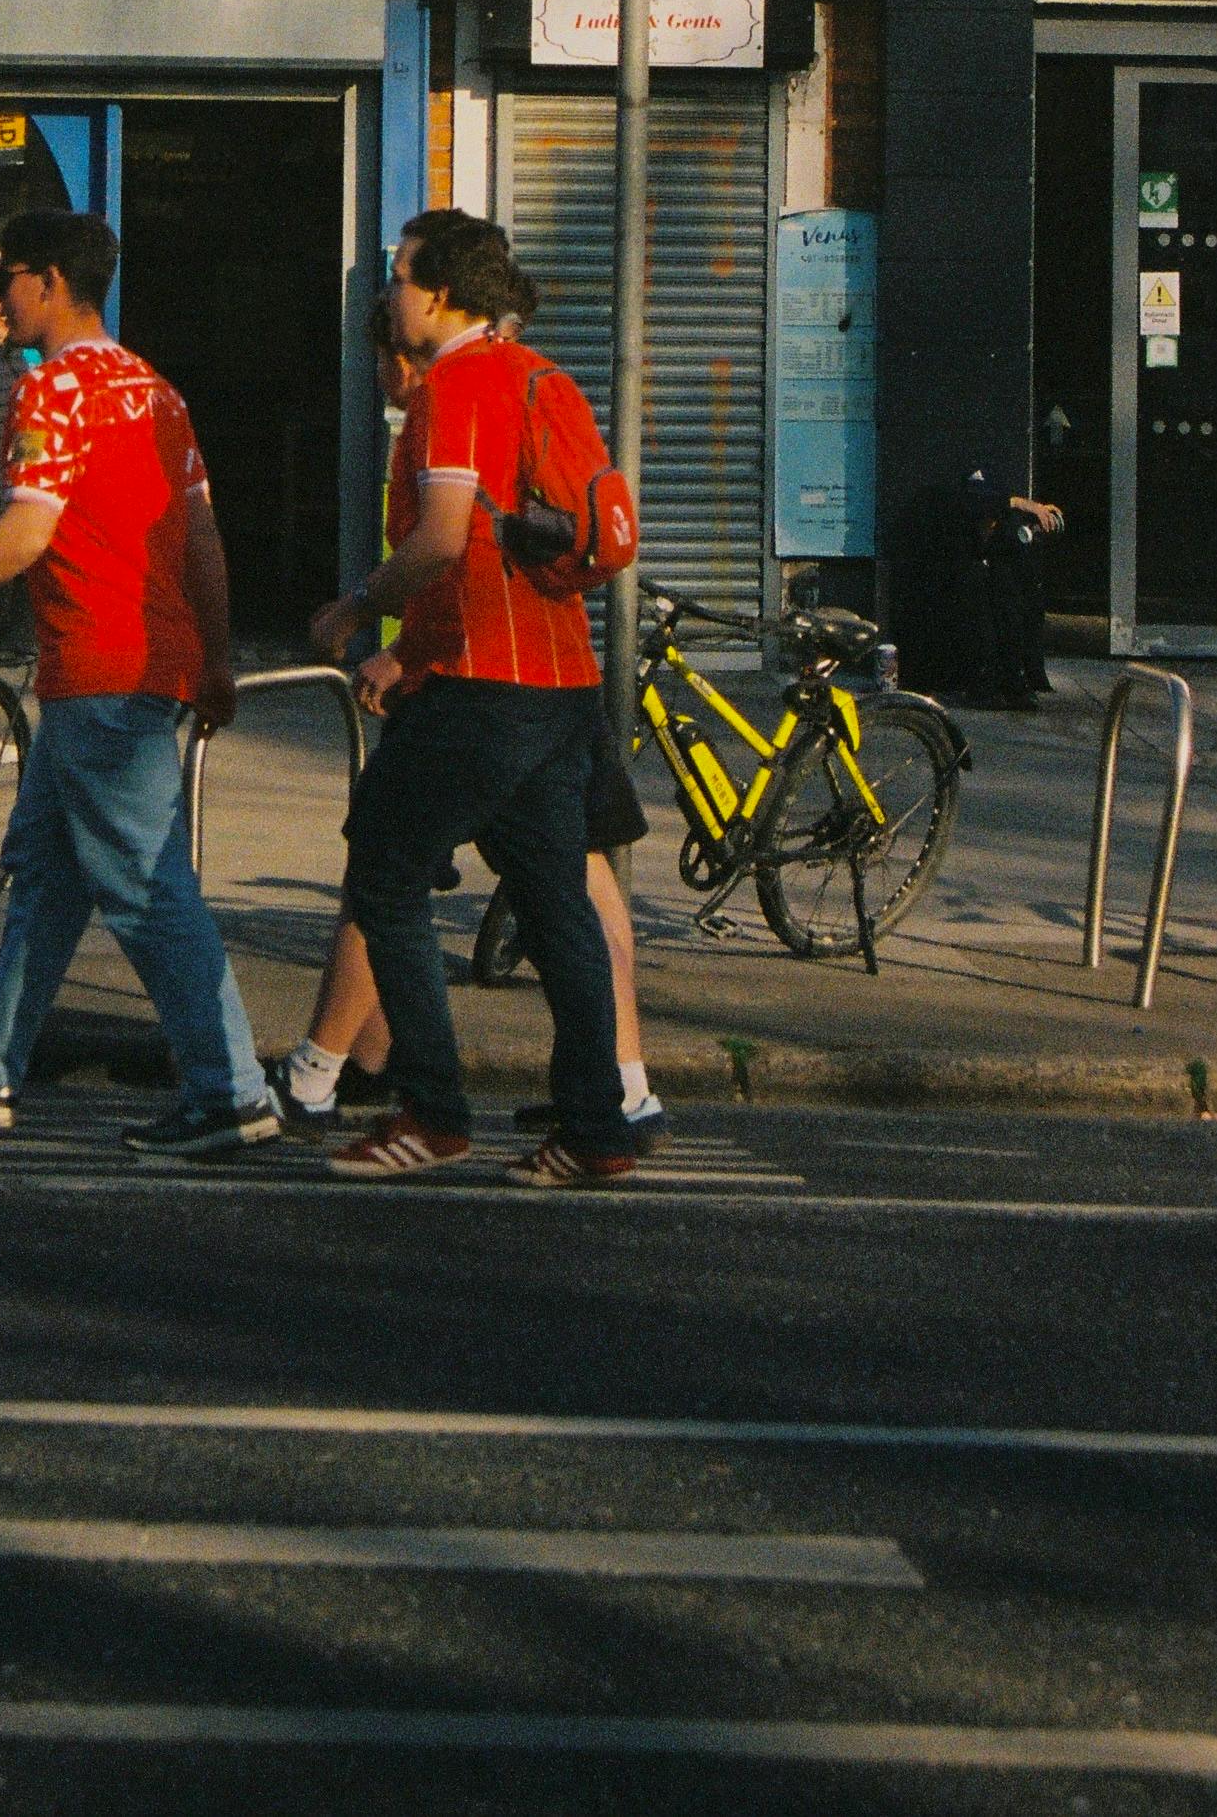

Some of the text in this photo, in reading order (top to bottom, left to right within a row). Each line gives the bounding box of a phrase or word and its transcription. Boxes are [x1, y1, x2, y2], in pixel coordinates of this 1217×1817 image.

[575, 13, 621, 29] Ladi
[667, 13, 721, 29] Gents
[802, 226, 858, 247] Venus
